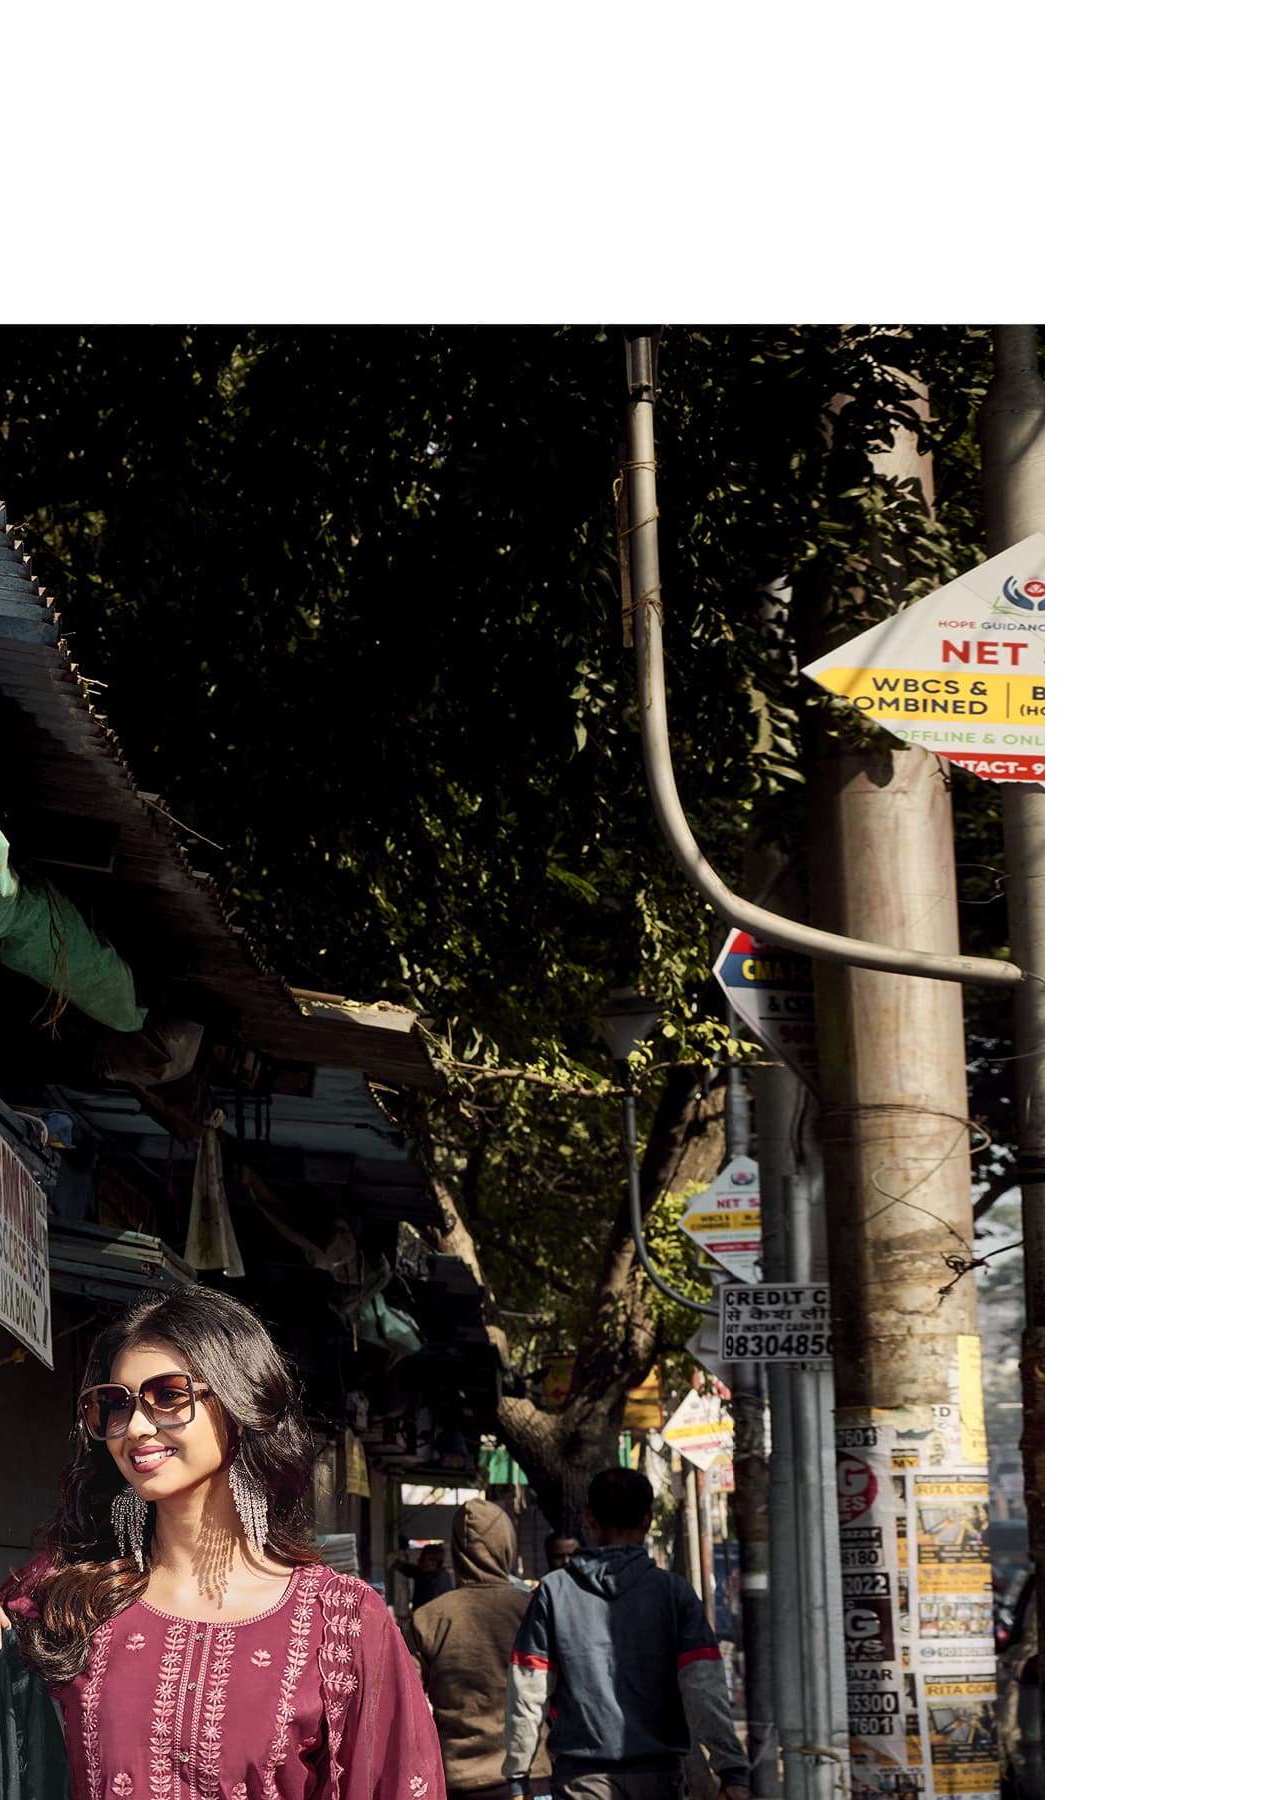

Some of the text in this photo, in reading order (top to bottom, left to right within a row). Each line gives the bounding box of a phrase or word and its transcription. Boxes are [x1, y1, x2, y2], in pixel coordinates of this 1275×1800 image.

[939, 620, 976, 630] HOPE
[941, 640, 1029, 667] NET
[872, 677, 960, 695] WBCS
[970, 681, 988, 696] &
[896, 730, 975, 744] OFFLINE
[983, 734, 996, 744] &
[717, 1199, 740, 1209] NET
[726, 1291, 804, 1306] CREDIT
[742, 1323, 783, 1333] INSTANT
[785, 1323, 811, 1333] CASH
[928, 1685, 963, 1697] RITA
